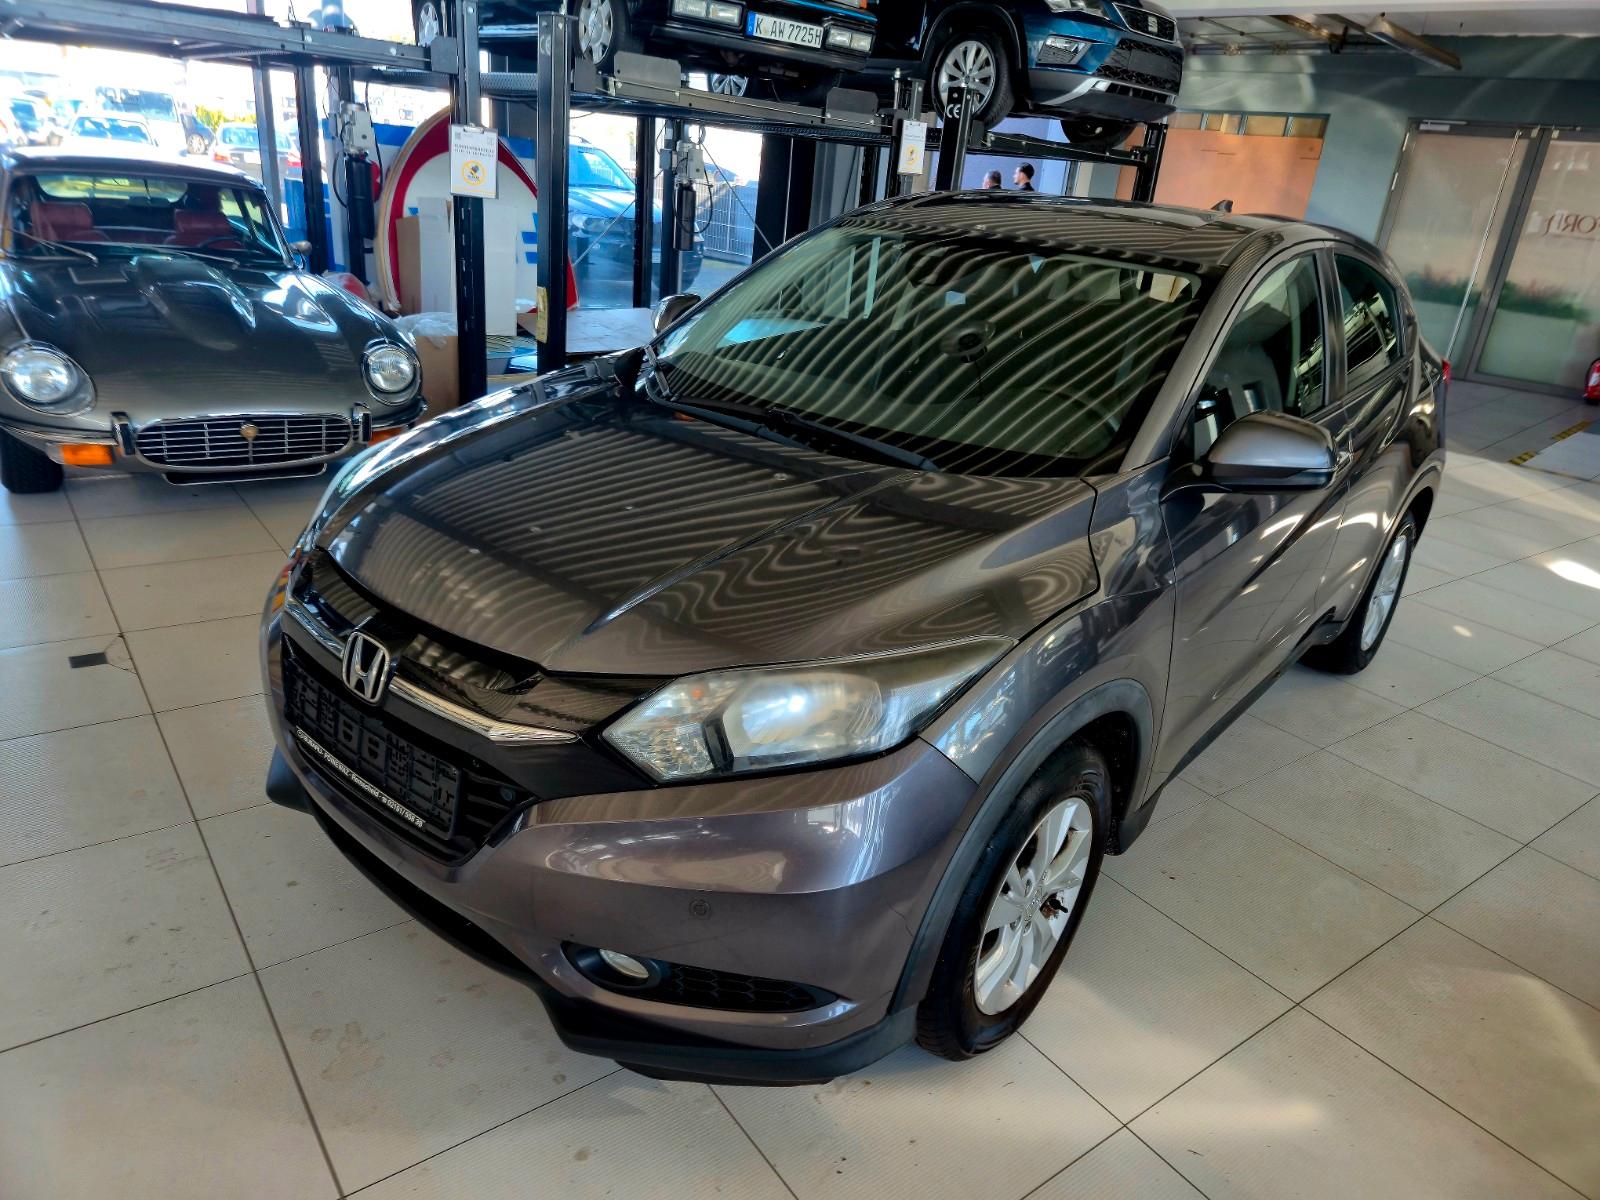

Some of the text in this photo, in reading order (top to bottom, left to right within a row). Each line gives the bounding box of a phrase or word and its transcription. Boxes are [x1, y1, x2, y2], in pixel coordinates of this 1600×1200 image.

[755, 17, 822, 46] K AW 7725H
[946, 103, 961, 119] CE
